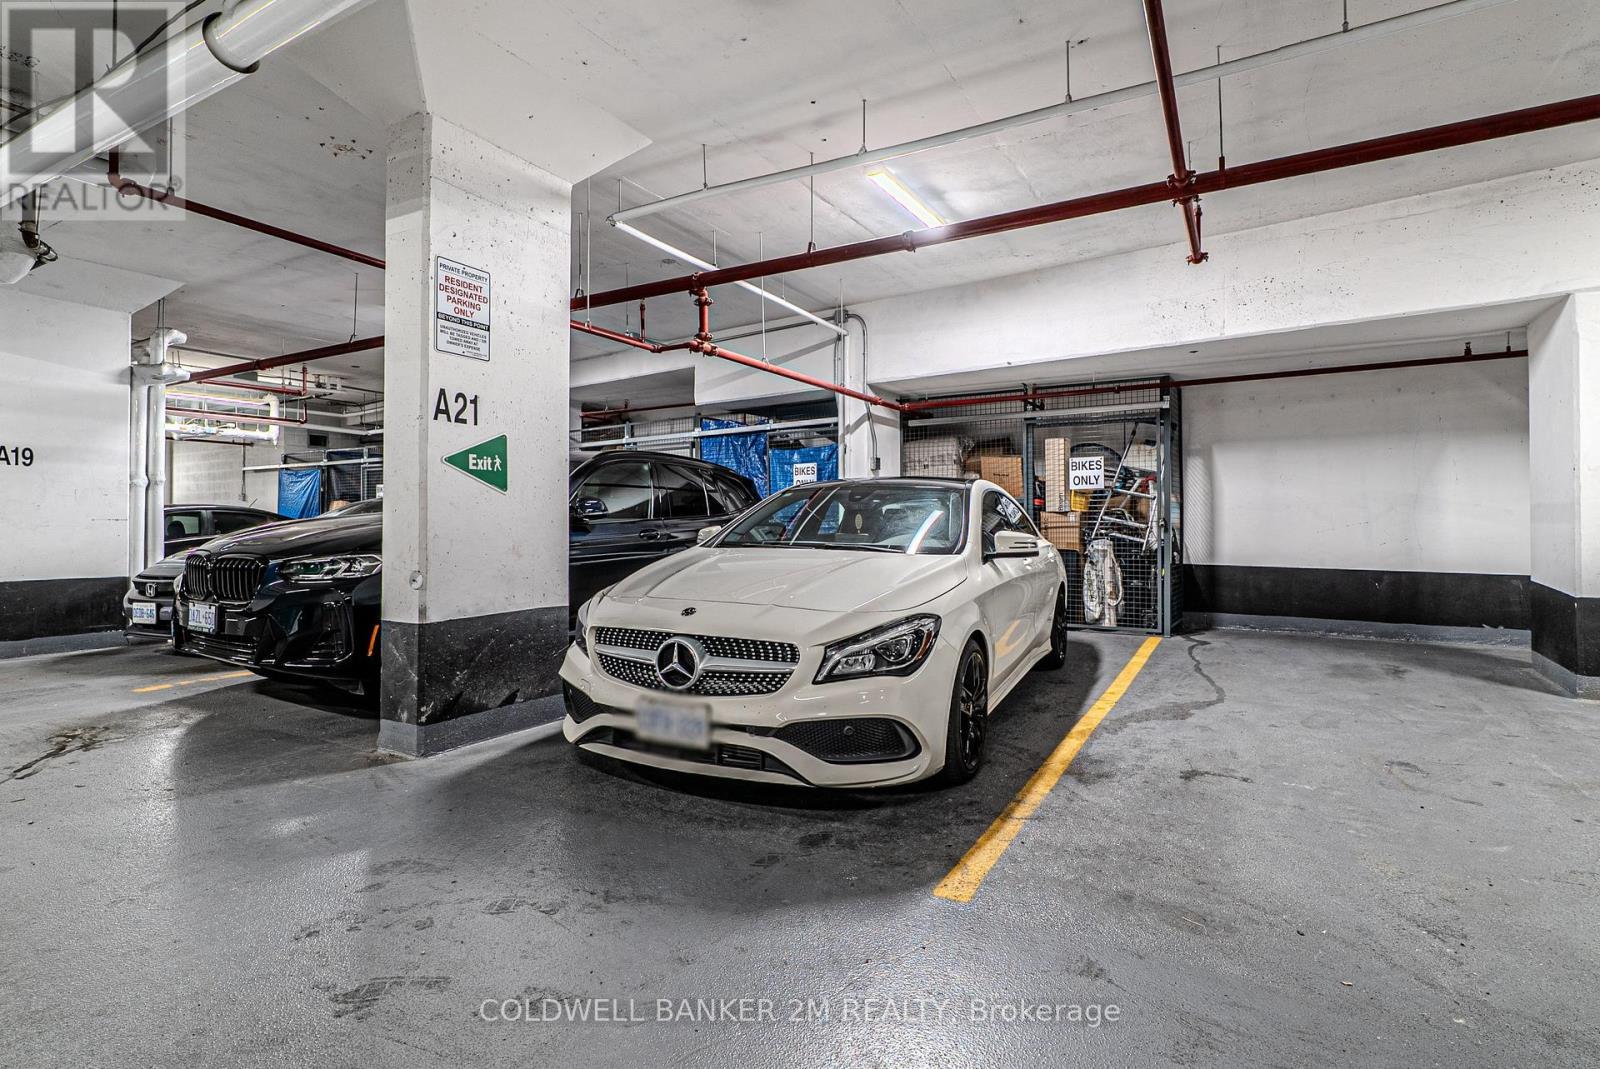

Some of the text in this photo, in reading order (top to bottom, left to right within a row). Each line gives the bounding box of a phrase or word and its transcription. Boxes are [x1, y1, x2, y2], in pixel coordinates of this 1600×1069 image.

[439, 262, 488, 283] PRIVATE PROPERTY
[439, 283, 488, 304] DESIGNATED
[444, 275, 483, 294] RESIDENT
[446, 296, 481, 311] PARKING
[453, 306, 475, 319] ONLY
[438, 312, 489, 331] BEYOND THIS POINT
[433, 388, 478, 426] A21
[0, 446, 34, 467] A19
[468, 453, 492, 471] Exit
[1071, 459, 1103, 471] BIKES
[794, 466, 816, 476] BIKES
[1073, 475, 1100, 486] ONLY
